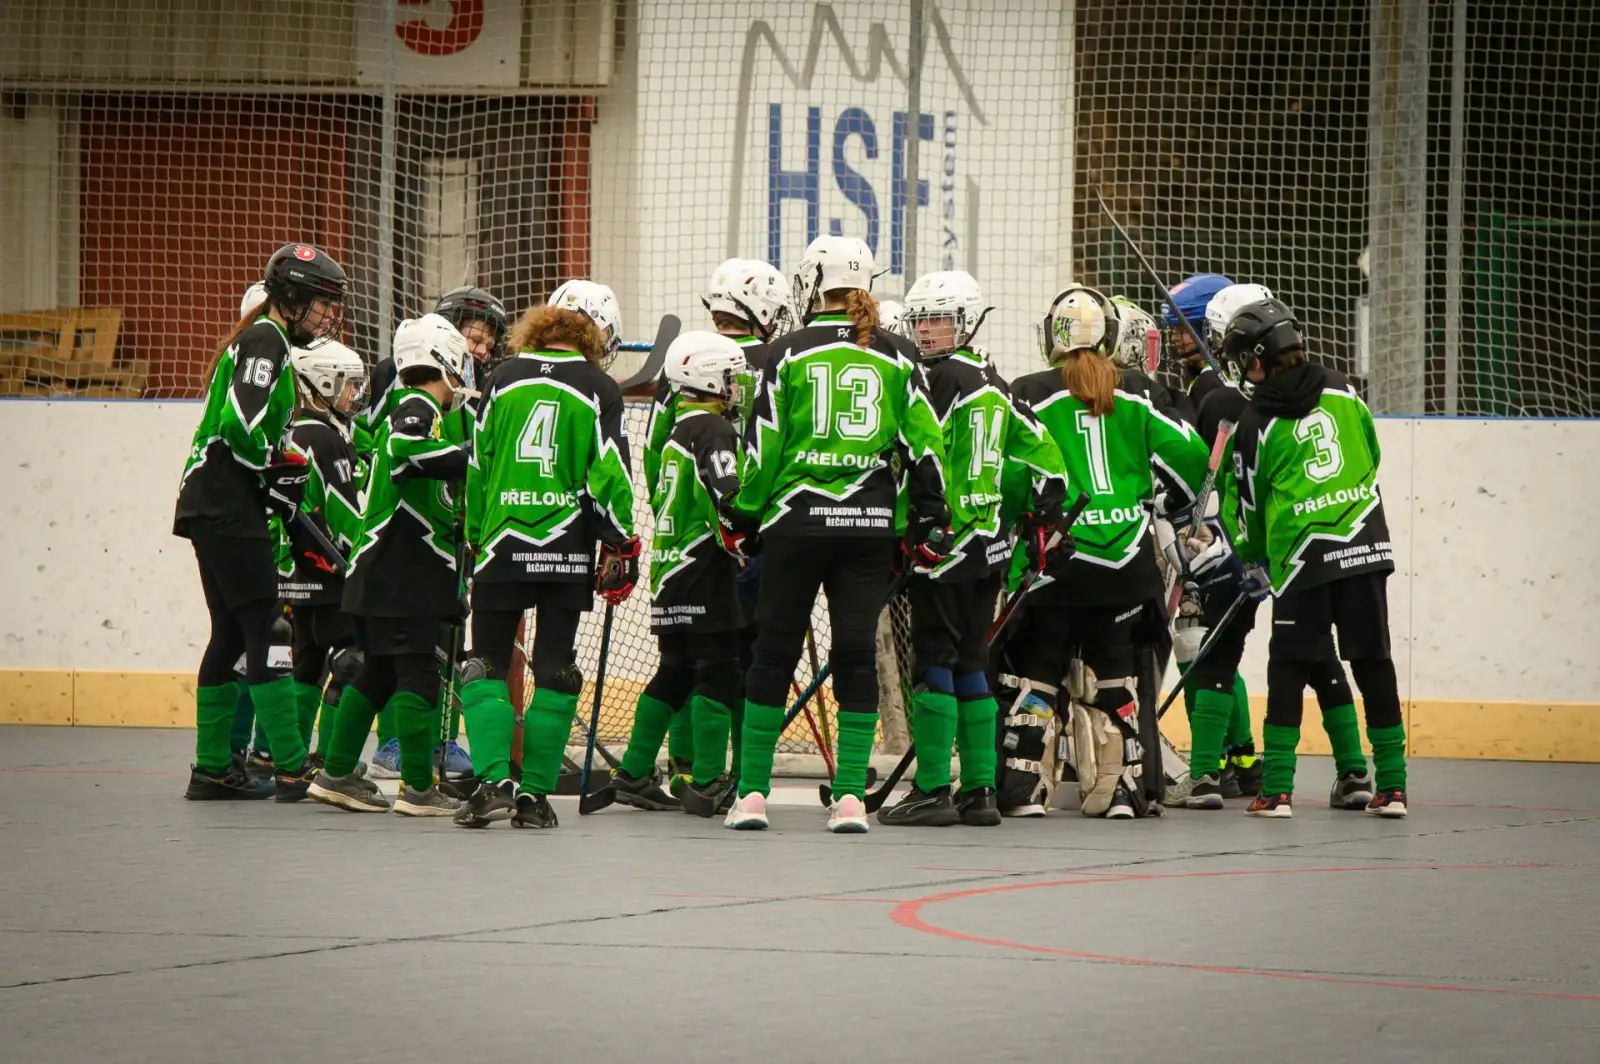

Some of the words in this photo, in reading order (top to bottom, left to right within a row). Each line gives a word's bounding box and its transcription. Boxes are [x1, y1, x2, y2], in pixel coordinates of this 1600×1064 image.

[768, 102, 935, 275] HSF
[847, 261, 859, 272] 13
[242, 357, 273, 387] 16
[806, 362, 883, 441] 13
[516, 400, 560, 478] 4
[967, 405, 1005, 480] 14
[1293, 407, 1344, 484] 3
[1075, 409, 1114, 495] 1
[710, 450, 737, 479] 12
[277, 474, 309, 485] CC
[500, 489, 576, 507] PŘELOUČ
[1293, 484, 1369, 516] PŘELOUČ
[809, 507, 862, 516] AUTOLAKOVNA
[825, 516, 854, 527] ŘEČANY
[855, 518, 870, 527] NAD
[512, 552, 563, 562] AUTOLAKOVNA
[1323, 544, 1371, 563] AUTOLAKOVNA
[1340, 555, 1366, 569] ŘEČANY
[1366, 553, 1382, 564] NAD
[526, 563, 554, 573] ŘEČANY
[555, 564, 570, 573] NAD
[1115, 604, 1143, 624] BAUER
